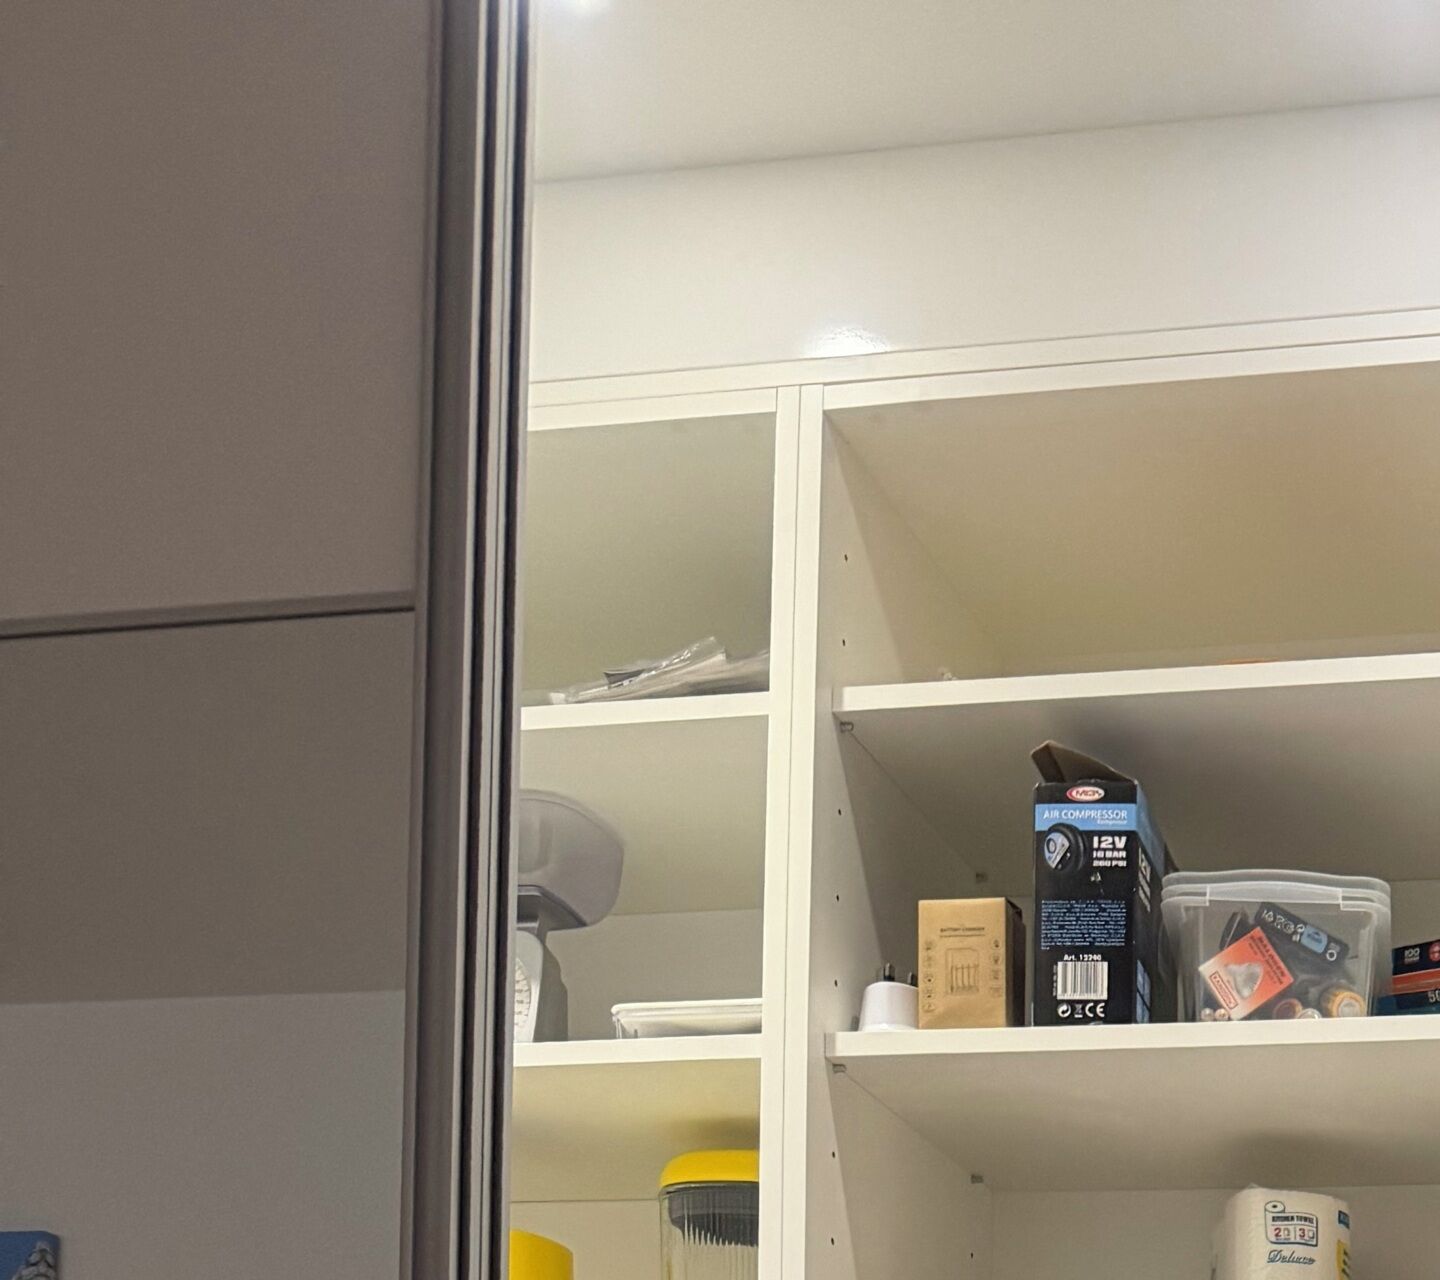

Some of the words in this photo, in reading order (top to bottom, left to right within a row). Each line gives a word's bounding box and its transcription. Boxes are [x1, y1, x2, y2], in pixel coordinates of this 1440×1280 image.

[1043, 809, 1059, 819] AIR
[1061, 809, 1128, 819] COMPRESSOR
[1092, 835, 1127, 849] 12V
[1274, 1227, 1282, 1238] 2
[1298, 1227, 1306, 1239] 3
[1266, 1249, 1317, 1265] Deluxe
